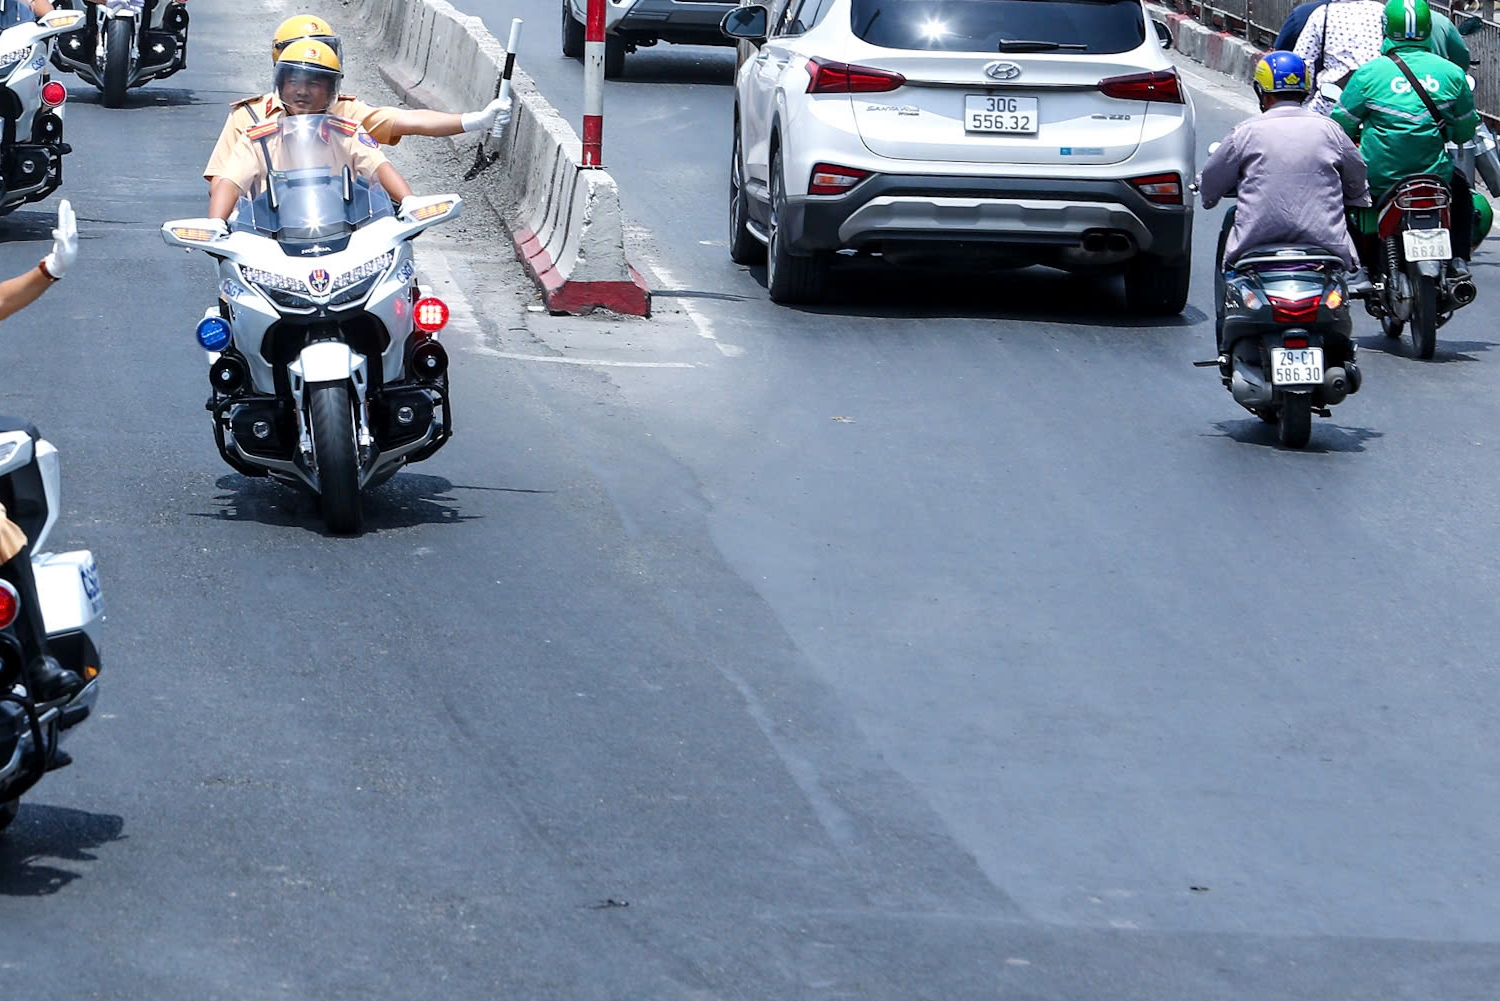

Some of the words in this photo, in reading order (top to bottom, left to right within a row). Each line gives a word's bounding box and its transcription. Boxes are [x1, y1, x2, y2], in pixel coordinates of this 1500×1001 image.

[986, 98, 1018, 112] 30G
[972, 114, 1030, 131] 556.32
[1280, 351, 1315, 366] 29-C1
[1276, 366, 1320, 382] 586.30
